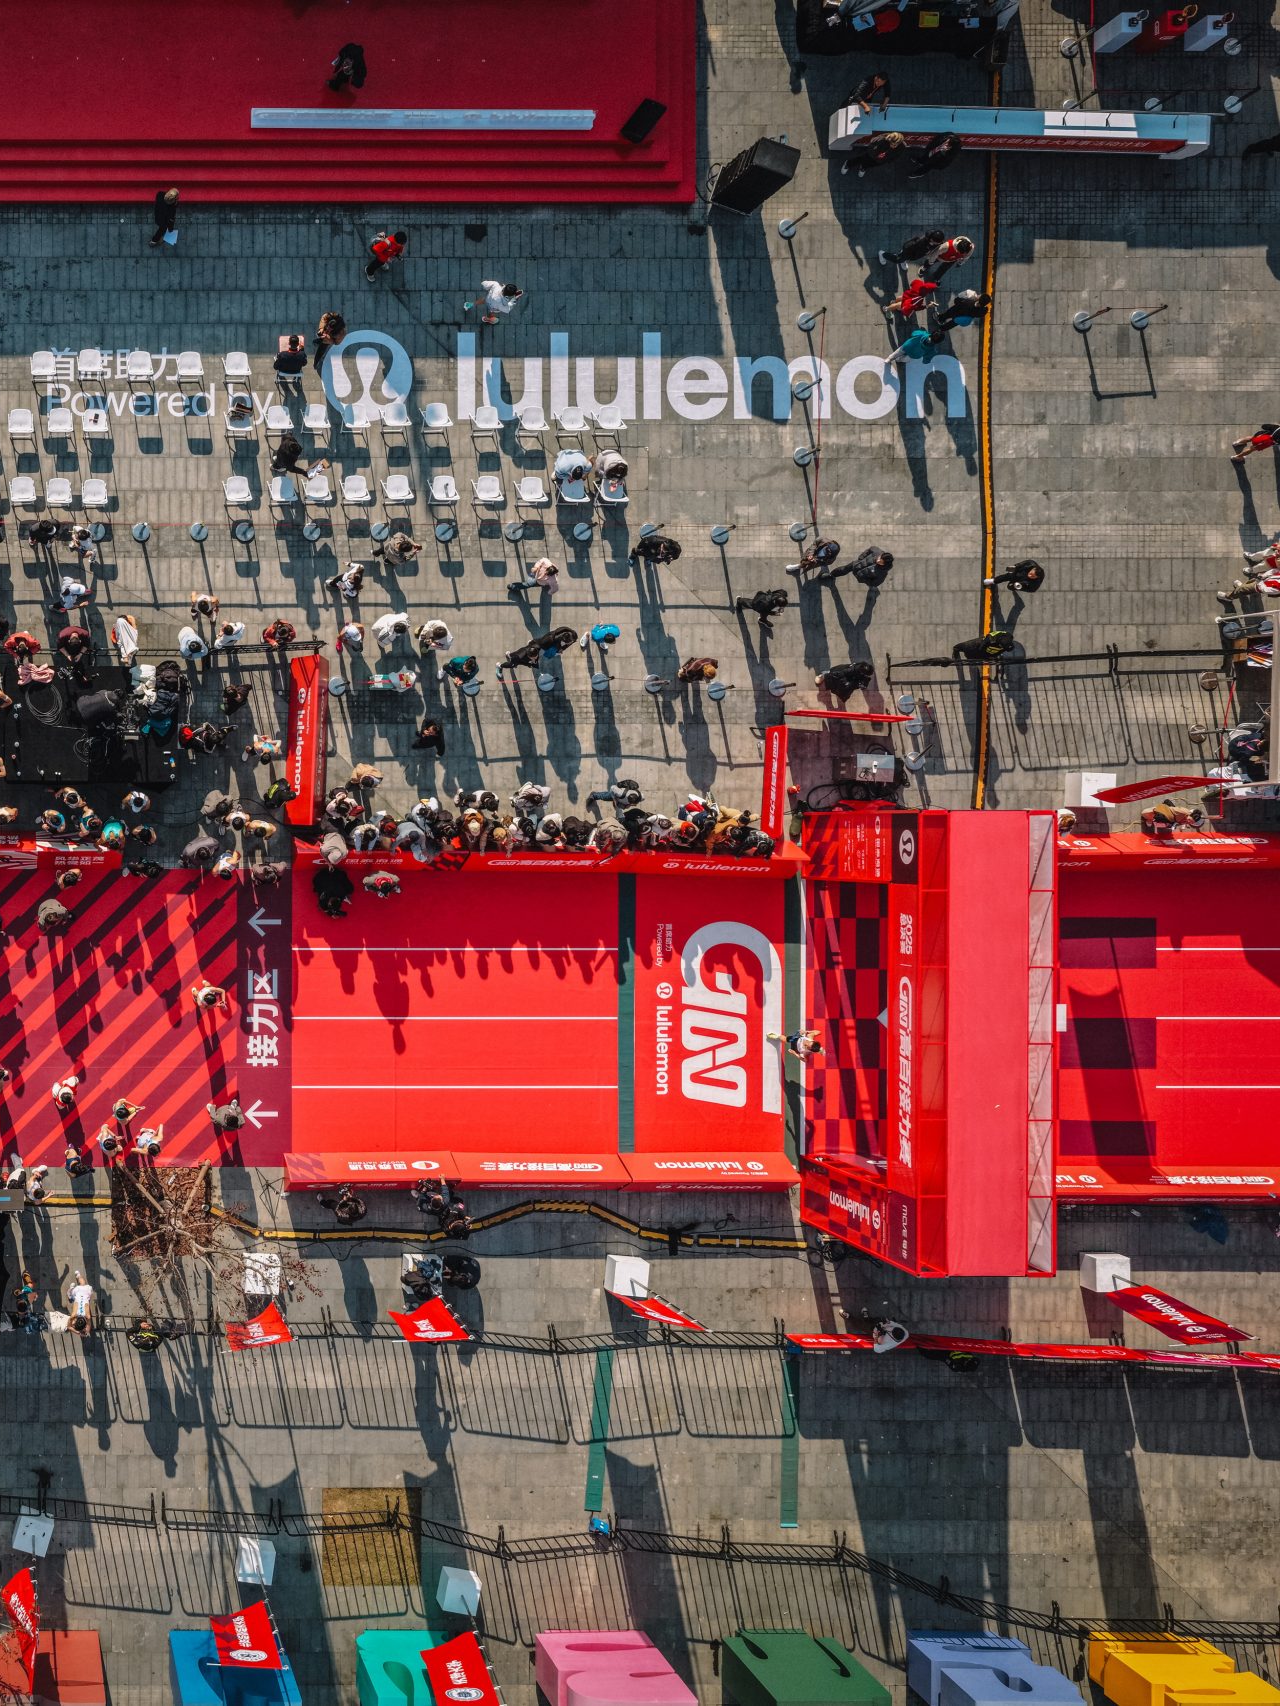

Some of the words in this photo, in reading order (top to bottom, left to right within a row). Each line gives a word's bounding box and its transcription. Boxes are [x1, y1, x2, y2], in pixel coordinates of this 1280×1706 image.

[457, 332, 967, 420] lululemon
[47, 384, 217, 418] Powered
[231, 384, 274, 426] by
[294, 709, 306, 796] lululemon
[683, 862, 771, 872] lululemon
[655, 923, 664, 956] Powered
[665, 923, 674, 953] 首席助力
[899, 913, 907, 955] 总决赛
[654, 957, 664, 968] by
[246, 969, 279, 1067] 接力区
[656, 1005, 673, 1095] lululemon
[898, 1030, 913, 1169] 高百接力赛
[497, 1161, 573, 1172] 高百接力赛
[654, 1161, 742, 1171] lululemon
[1166, 1174, 1244, 1185] 高百接力赛
[829, 1190, 871, 1227] lululemon
[1140, 1293, 1197, 1327] lululemon
